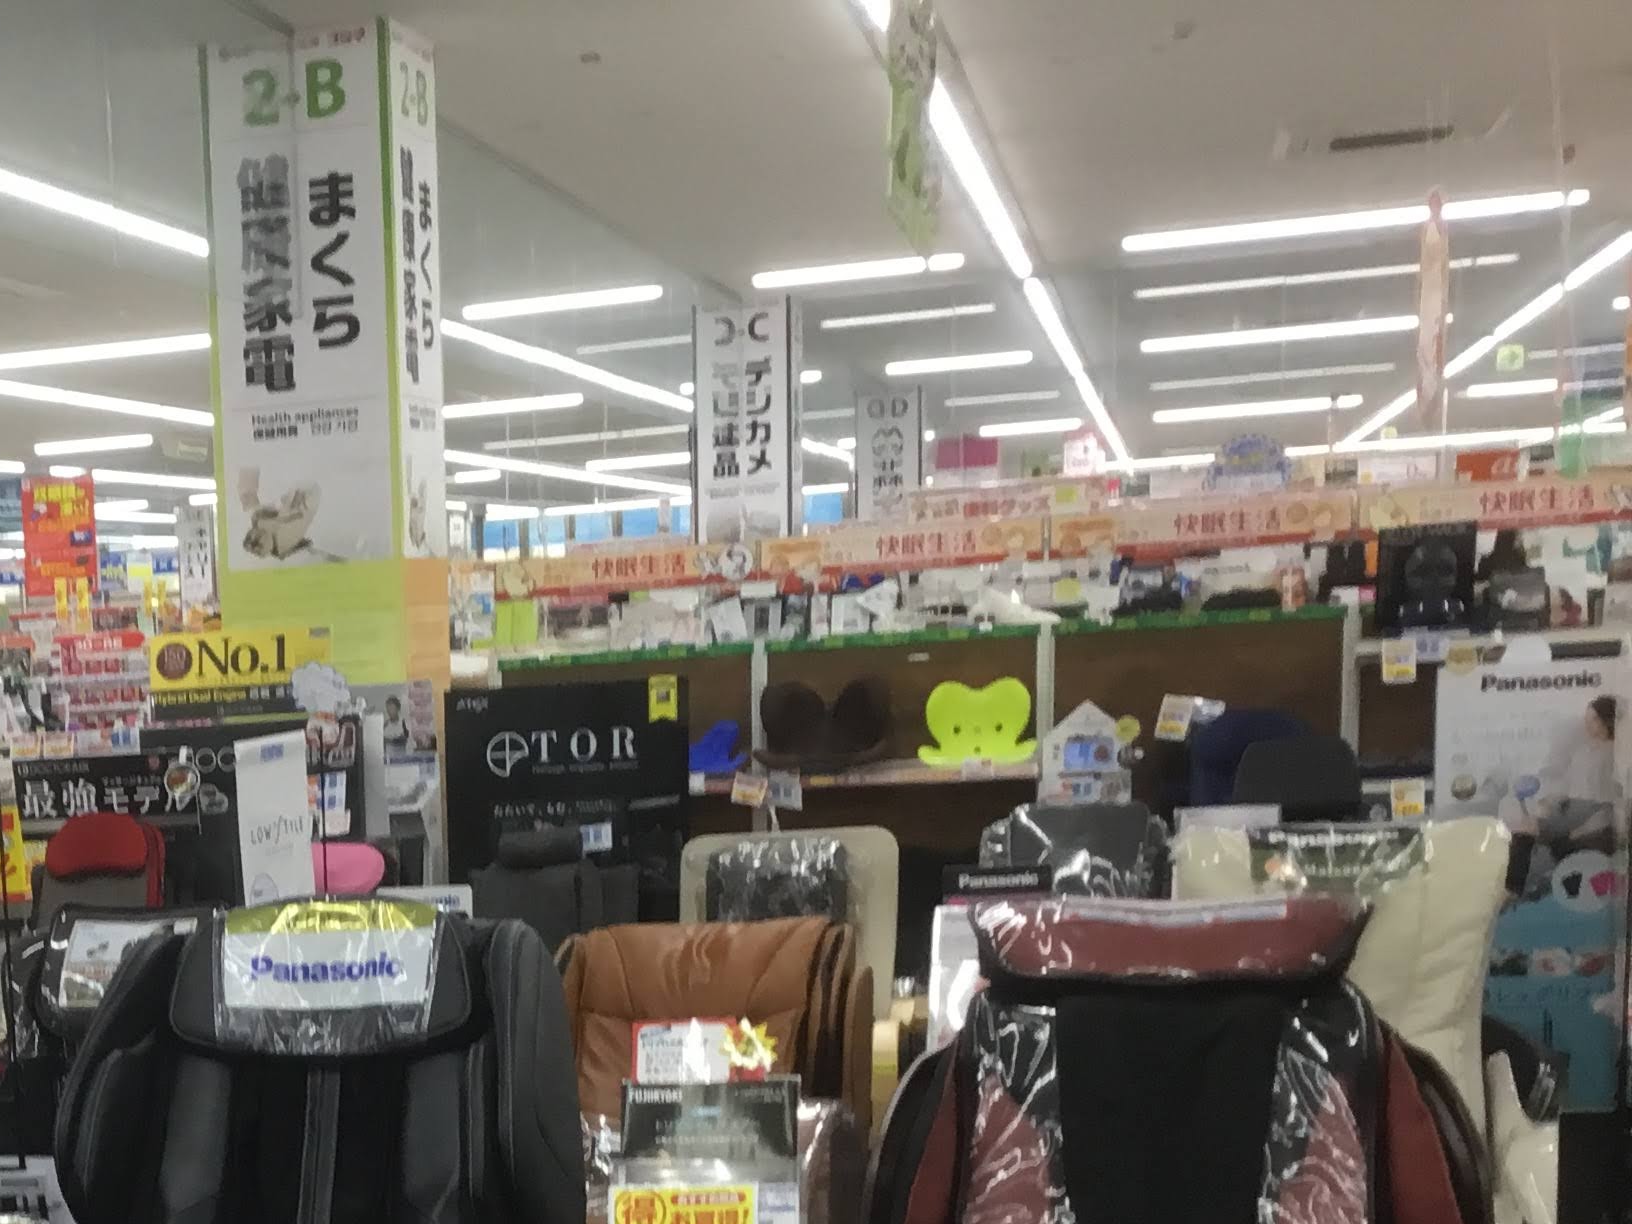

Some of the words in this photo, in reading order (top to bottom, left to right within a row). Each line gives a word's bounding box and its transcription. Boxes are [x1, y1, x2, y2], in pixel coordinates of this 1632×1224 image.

[242, 58, 346, 127] 2-B
[308, 170, 361, 350] まくら
[418, 180, 435, 350] まくら
[252, 412, 291, 425] Health
[295, 406, 358, 425] appliances
[1479, 484, 1594, 515] 快眠生活
[1174, 507, 1281, 536] 快眠生活
[876, 529, 976, 558] 快眠生活
[591, 552, 685, 580] 快眠生活
[197, 634, 286, 677] No.1
[1480, 671, 1602, 693] Panasonic
[250, 951, 401, 984] Panasonic
